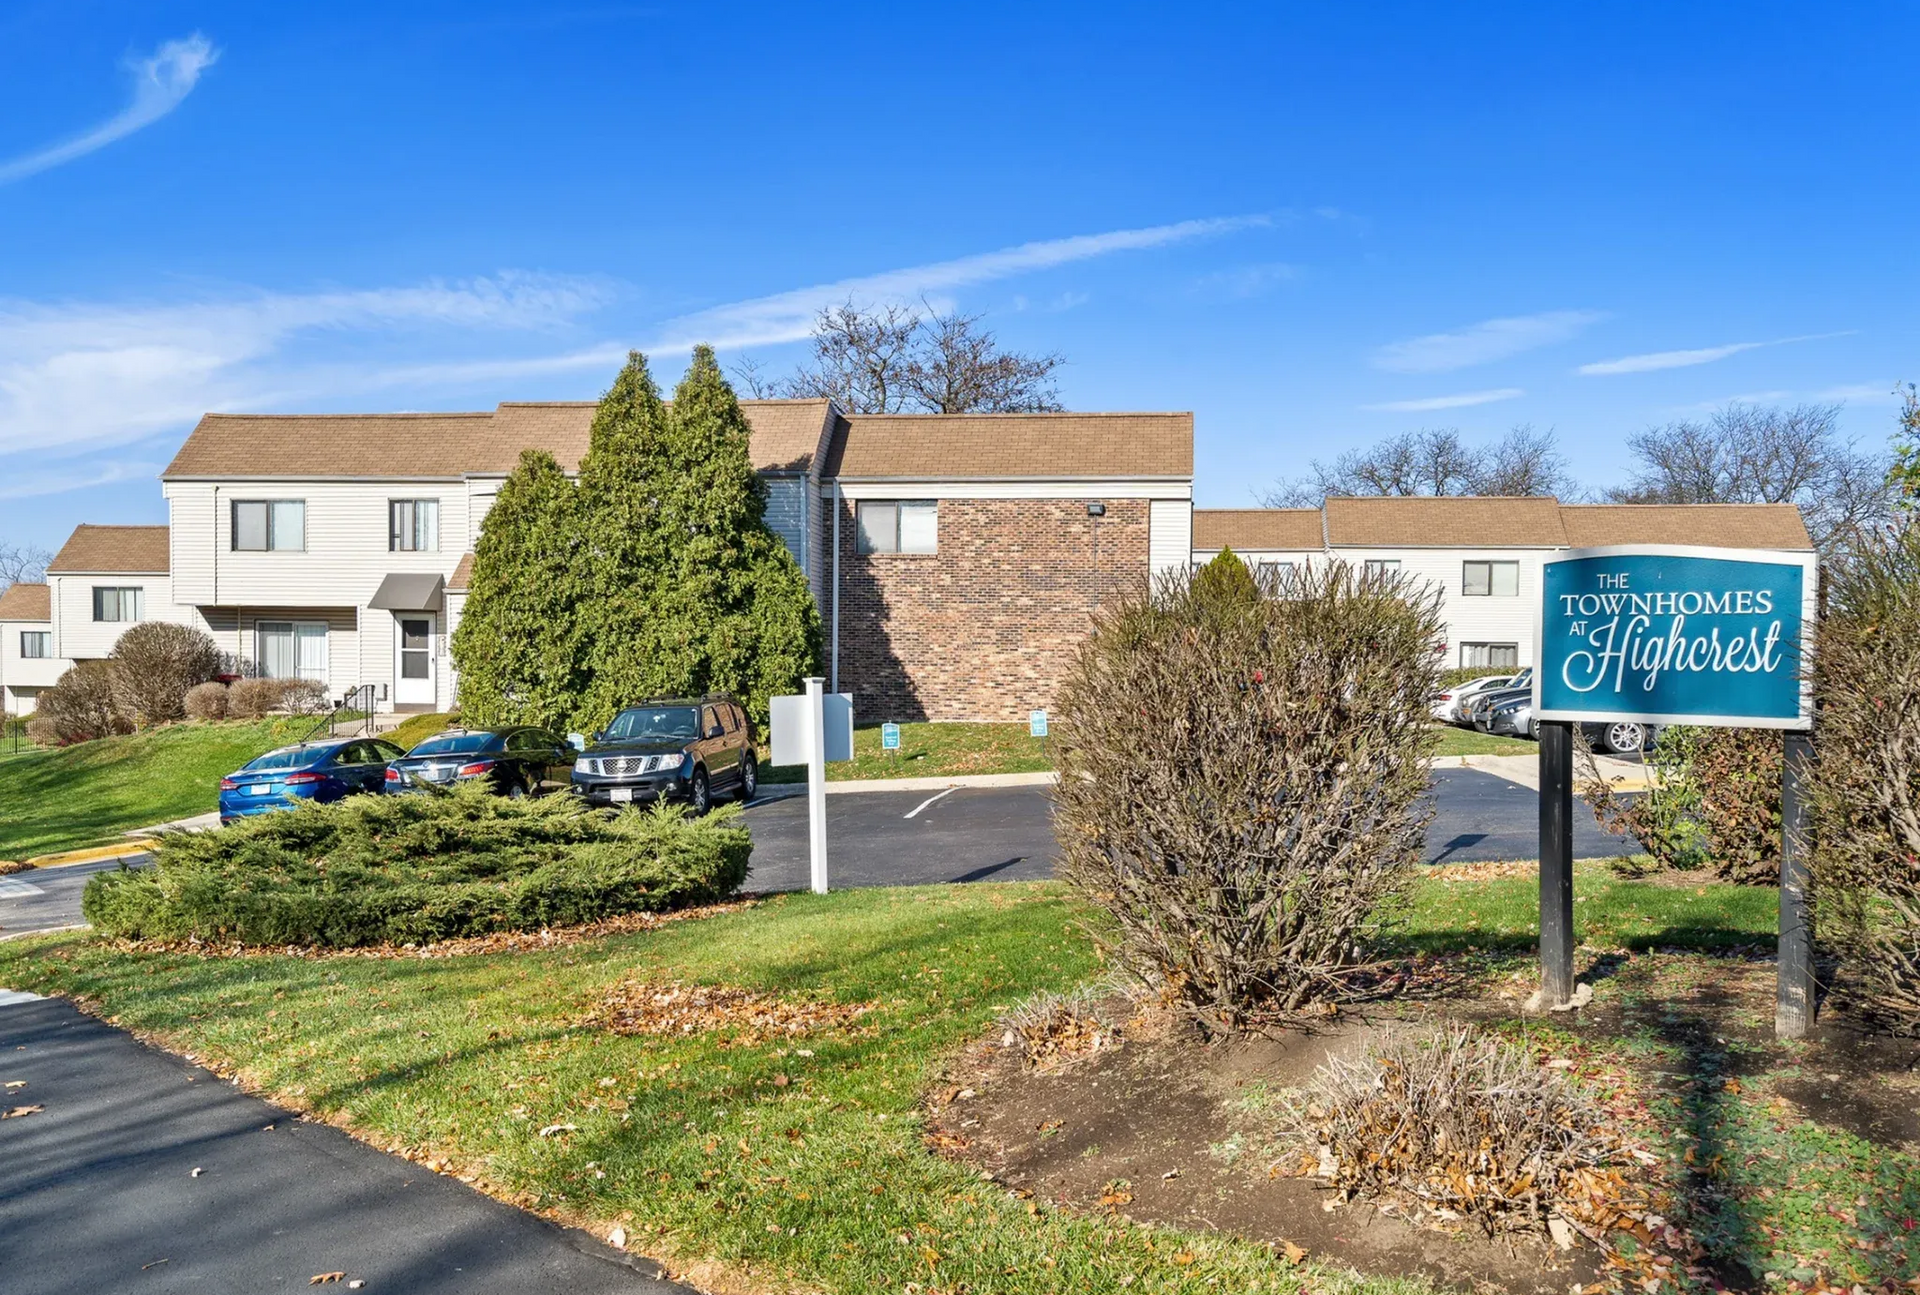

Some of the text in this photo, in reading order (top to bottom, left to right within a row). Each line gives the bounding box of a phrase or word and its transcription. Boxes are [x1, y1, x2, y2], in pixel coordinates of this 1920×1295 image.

[1597, 573, 1630, 589] THE
[1560, 590, 1772, 616] TOWNHOMES
[1562, 614, 1782, 693] AT Highcrest
